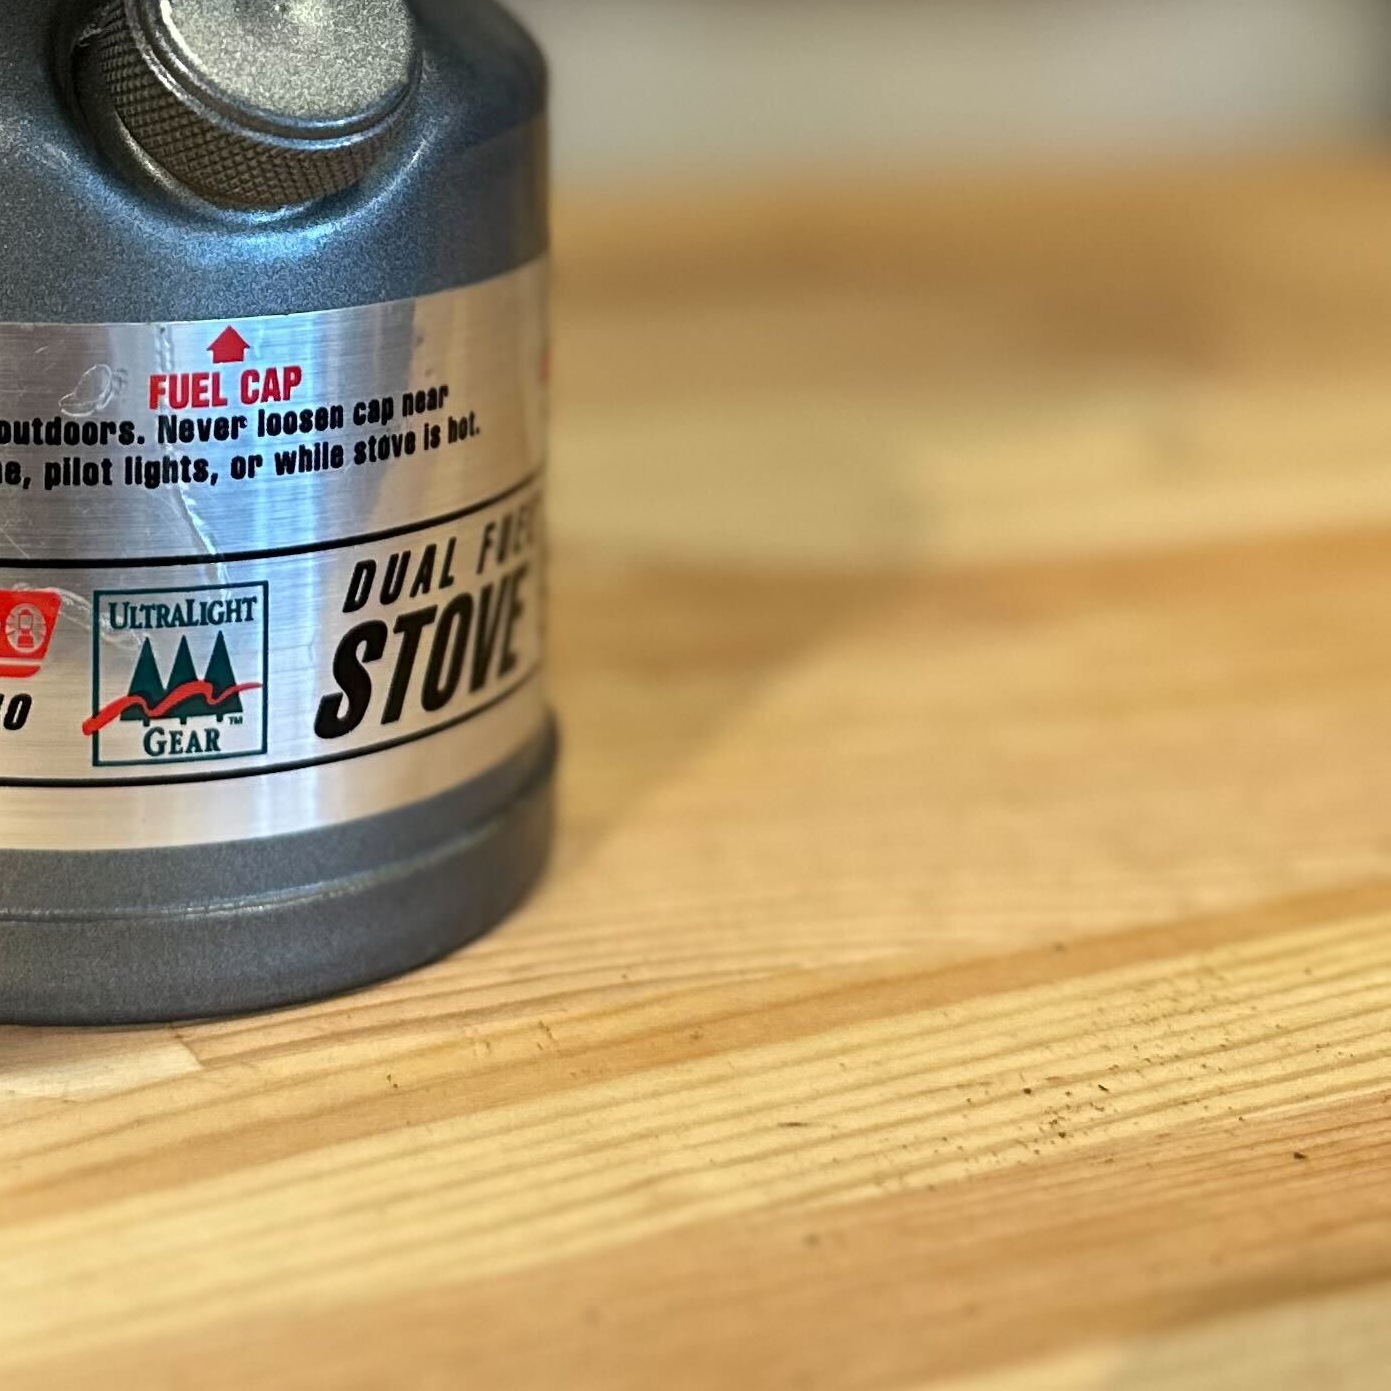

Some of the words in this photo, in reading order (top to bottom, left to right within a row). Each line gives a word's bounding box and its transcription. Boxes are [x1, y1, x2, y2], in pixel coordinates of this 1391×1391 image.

[148, 371, 228, 410] FUEL
[240, 365, 303, 405] CAP
[157, 414, 248, 445] Never
[257, 405, 344, 438] loosen
[352, 396, 394, 426] cap
[401, 384, 449, 418] near
[44, 456, 113, 491] pilot
[124, 455, 219, 490] lights,
[230, 453, 263, 480] or
[274, 441, 345, 476] while
[353, 430, 417, 466] stove
[423, 422, 441, 451] is
[447, 410, 481, 445] hot.
[342, 536, 457, 613] DUAL
[313, 563, 529, 739] STOVE
